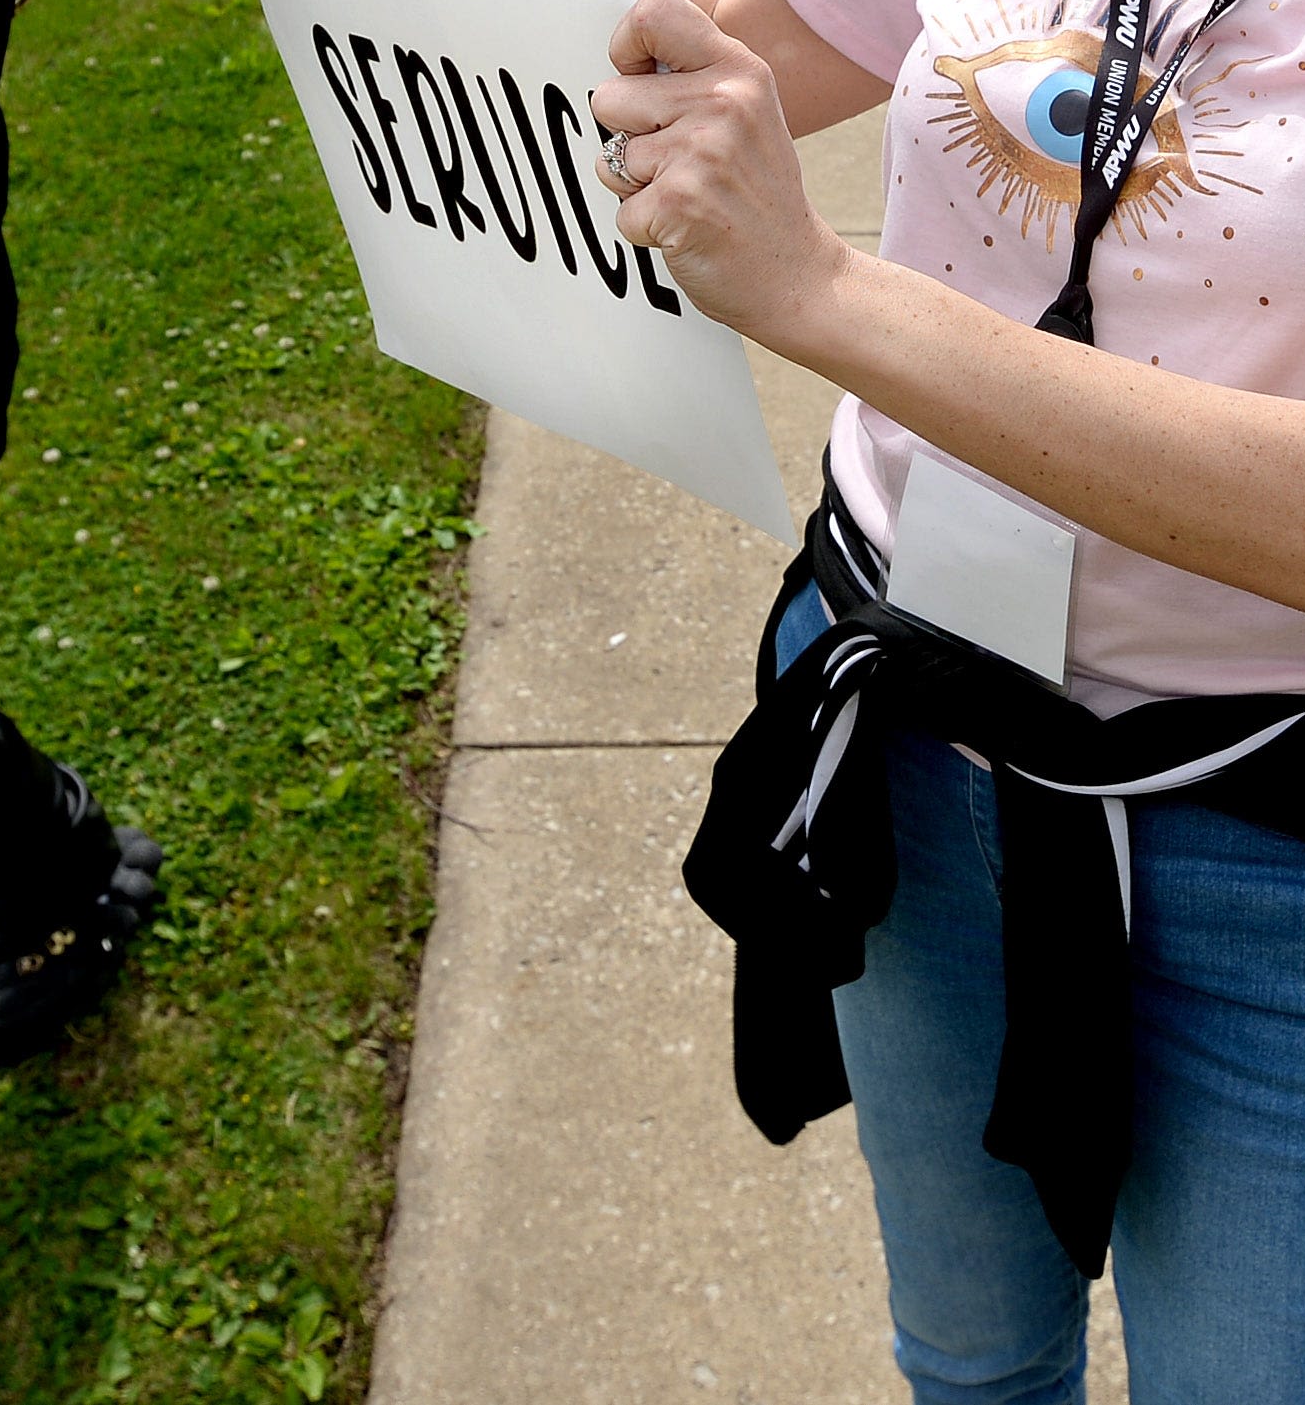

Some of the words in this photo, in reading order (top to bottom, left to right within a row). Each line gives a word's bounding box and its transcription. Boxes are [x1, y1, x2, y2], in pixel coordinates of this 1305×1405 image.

[1105, 58, 1129, 105] UNION
[1091, 107, 1119, 171] MEMB
[1101, 114, 1141, 189] APWU
[1146, 60, 1179, 106] UNION
